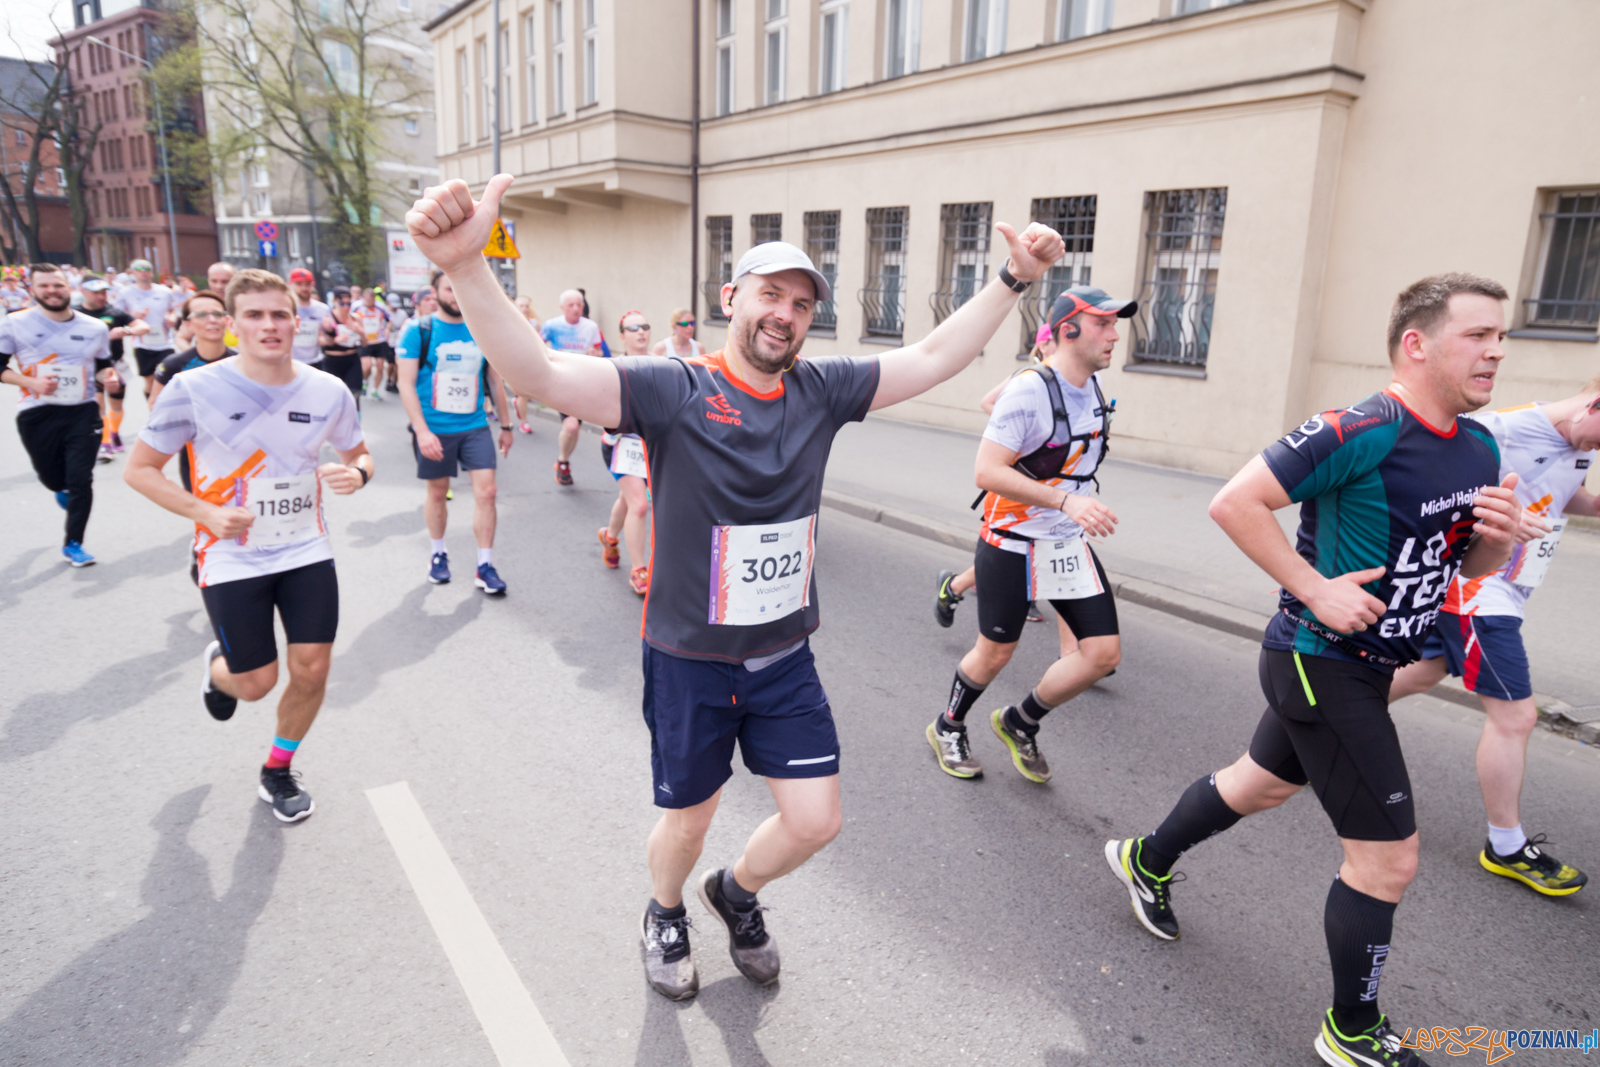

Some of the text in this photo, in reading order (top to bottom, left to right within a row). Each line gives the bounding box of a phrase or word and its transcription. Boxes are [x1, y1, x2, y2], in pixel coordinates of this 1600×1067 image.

[447, 386, 469, 397] 295
[705, 410, 742, 426] umbro
[256, 494, 313, 516] 11884
[741, 550, 802, 583] 3022
[1050, 555, 1080, 573] 1151
[756, 583, 791, 595] Waldemar
